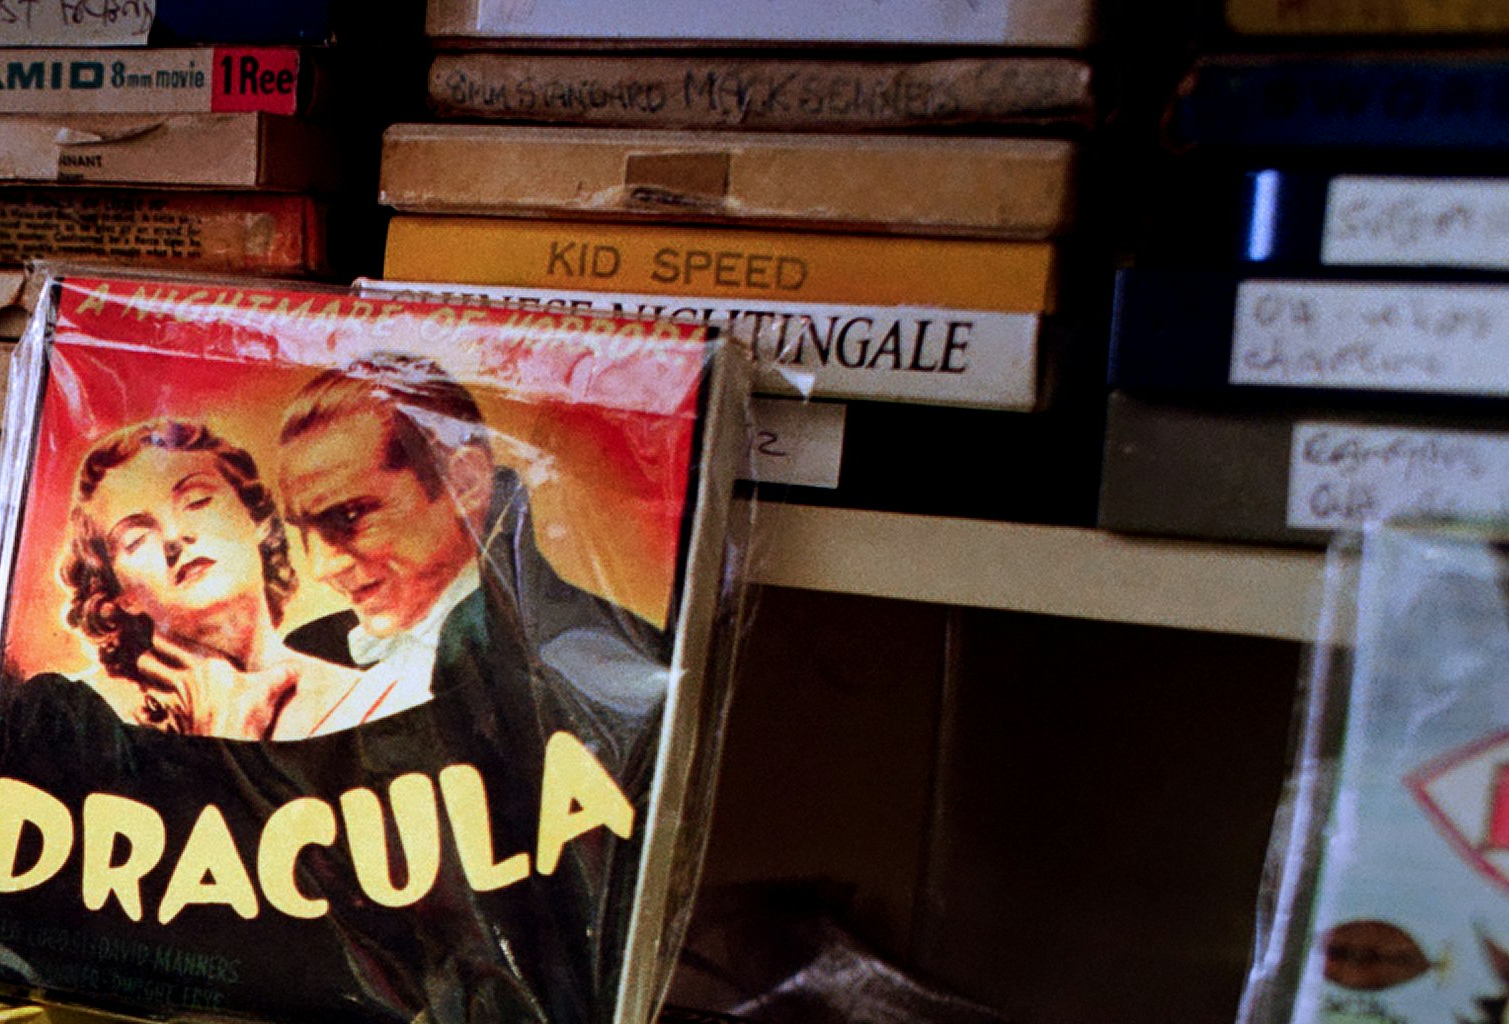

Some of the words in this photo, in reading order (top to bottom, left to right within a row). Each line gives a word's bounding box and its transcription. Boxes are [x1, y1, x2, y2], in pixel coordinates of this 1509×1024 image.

[112, 62, 152, 89] 8mm
[155, 63, 205, 89] movie
[221, 55, 232, 96] 1
[239, 55, 295, 96] Ree
[545, 240, 621, 279] KID
[650, 247, 808, 292] SPEED
[76, 283, 112, 316] A
[121, 284, 404, 336] NIGHTMARE
[420, 303, 488, 342] OF
